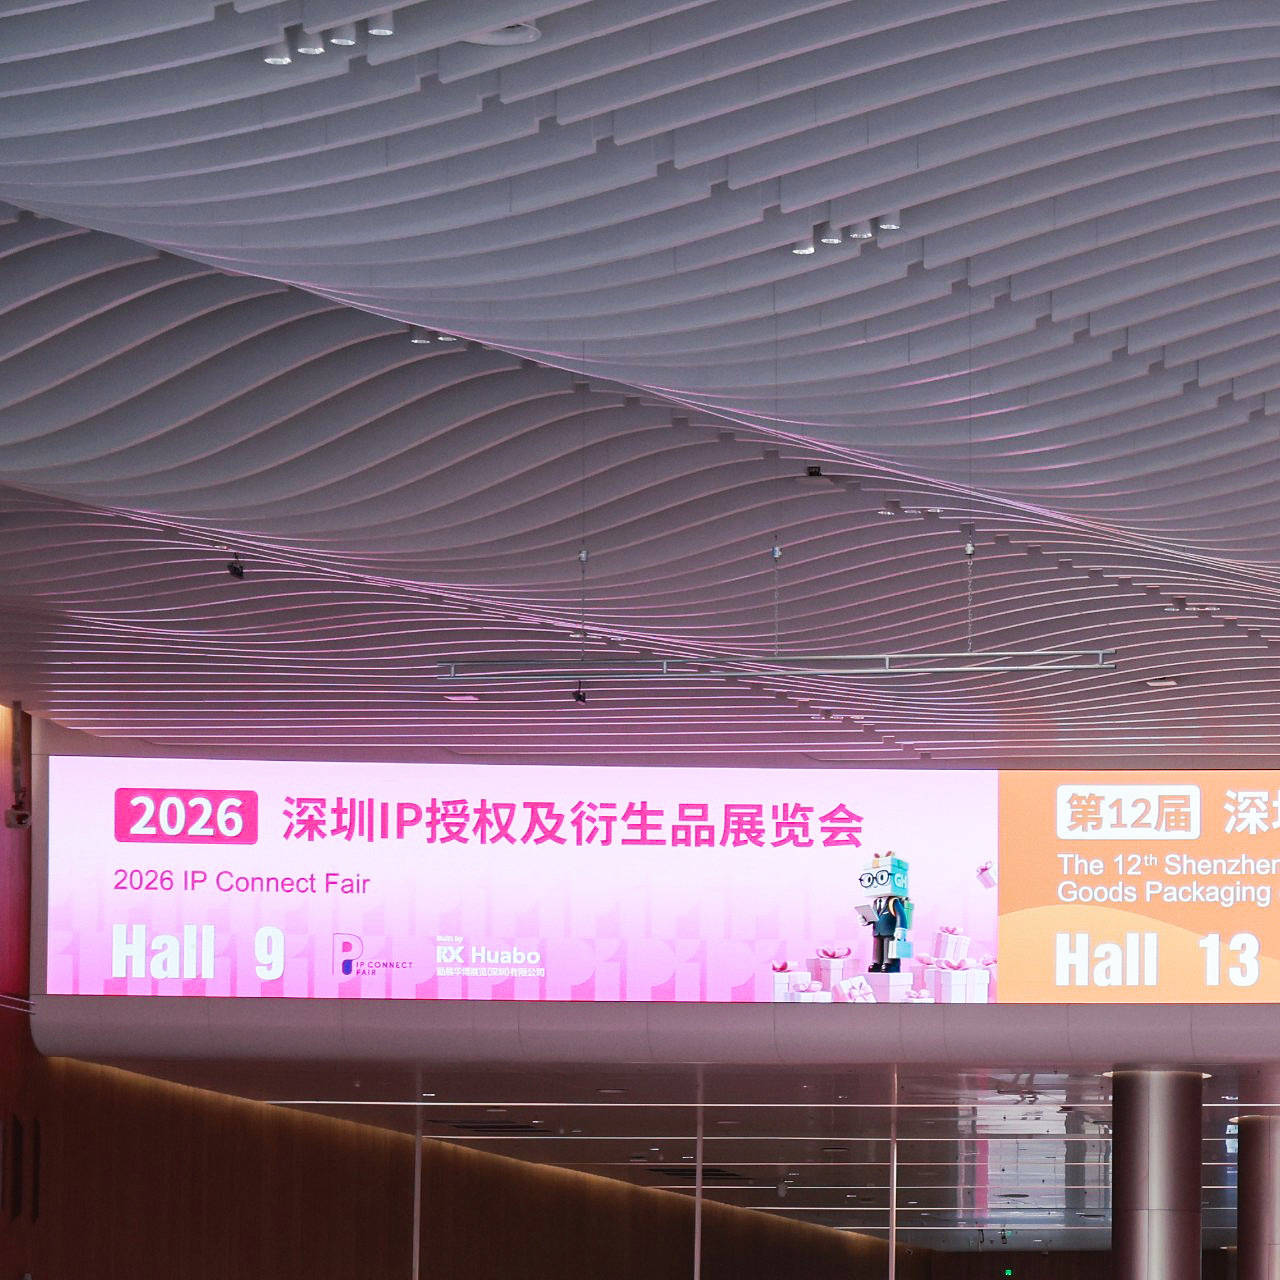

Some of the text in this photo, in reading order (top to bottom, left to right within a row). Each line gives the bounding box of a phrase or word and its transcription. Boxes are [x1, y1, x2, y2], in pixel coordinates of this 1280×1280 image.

[129, 795, 244, 838] 2026
[282, 794, 864, 848] 深圳IP授权及衍生品展览会
[1066, 791, 1193, 834] 第12届
[113, 868, 371, 894] 2026 IP Connect Fair
[1057, 854, 1105, 876] The
[1113, 853, 1158, 876] 12th
[1057, 881, 1140, 904] Goods
[1146, 880, 1273, 908] Packaging
[111, 923, 286, 981] Hall 9
[436, 945, 541, 964] RX Huabo
[1055, 932, 1260, 987] Hall 13
